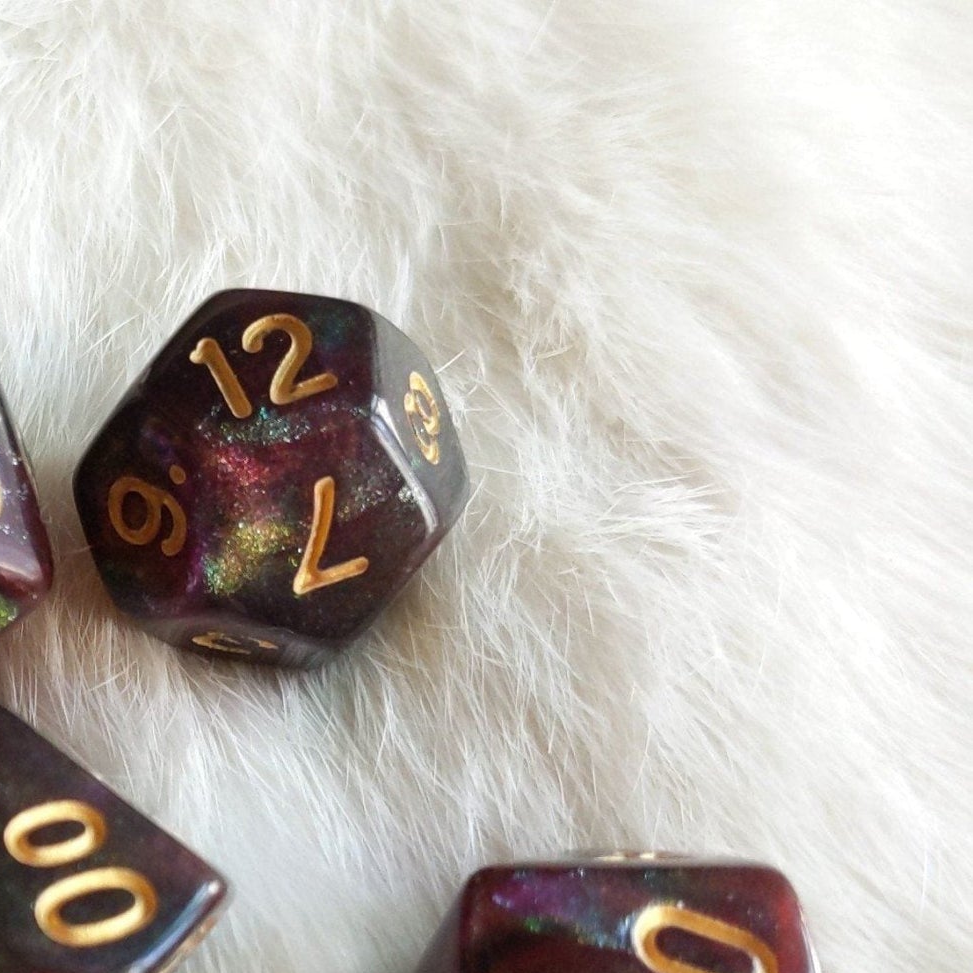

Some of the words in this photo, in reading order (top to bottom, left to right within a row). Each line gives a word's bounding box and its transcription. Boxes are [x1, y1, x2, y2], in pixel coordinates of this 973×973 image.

[190, 313, 338, 418] 12
[293, 476, 369, 596] 7
[3, 799, 159, 948] 00
